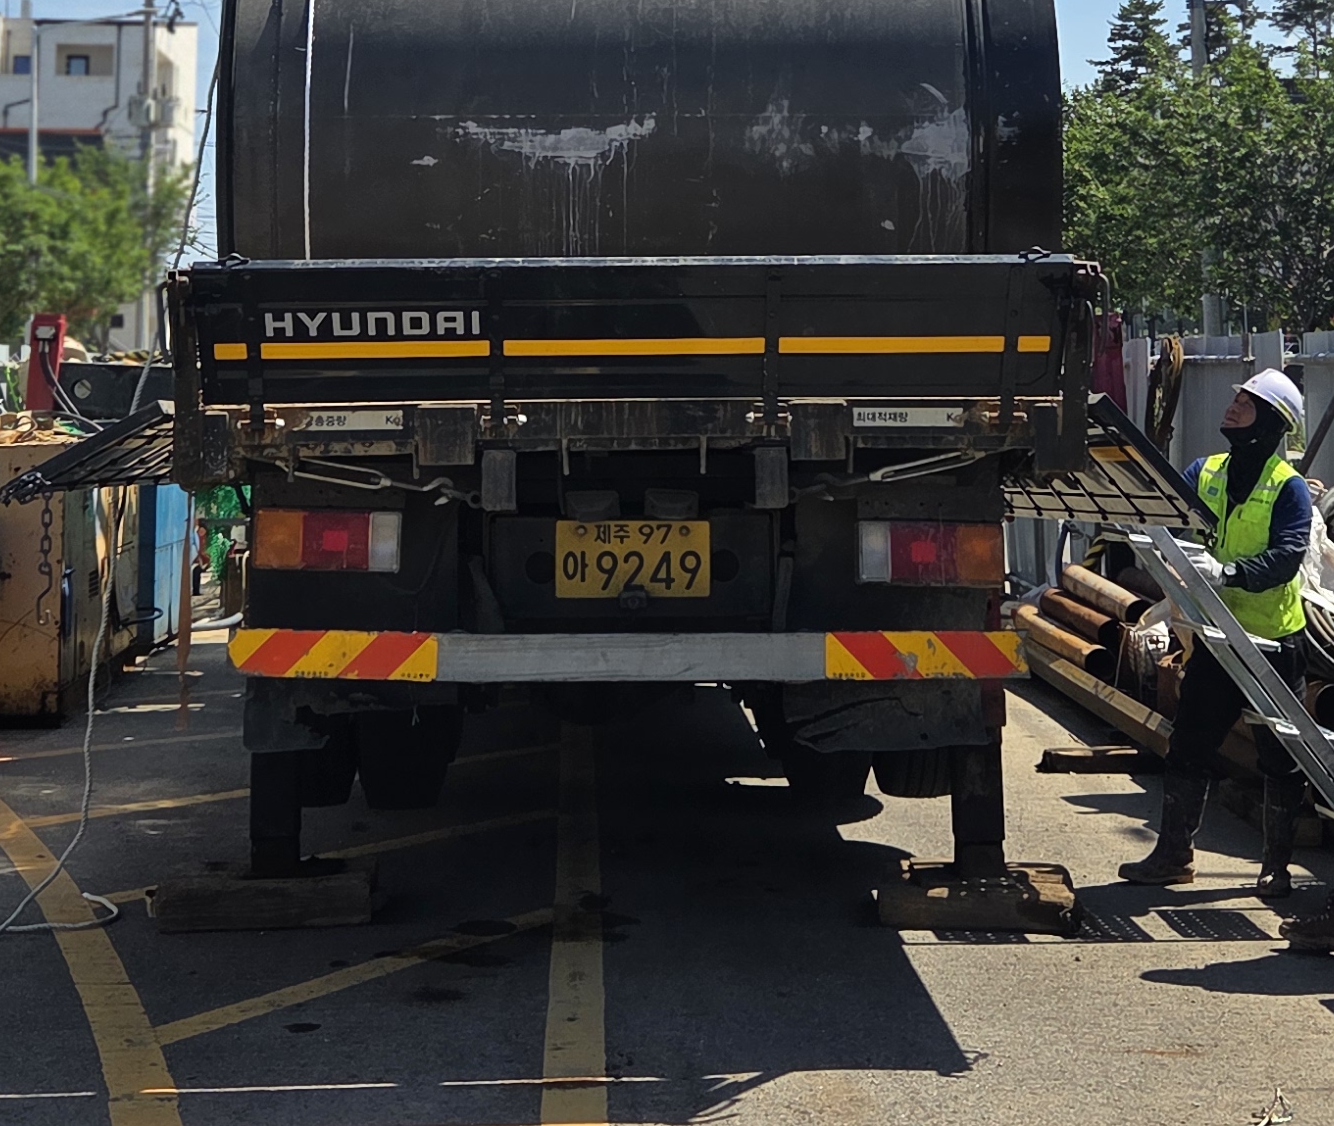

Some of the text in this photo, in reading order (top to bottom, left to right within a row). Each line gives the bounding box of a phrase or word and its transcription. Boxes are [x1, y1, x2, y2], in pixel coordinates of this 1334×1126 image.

[264, 310, 480, 337] HYUNDAI
[856, 411, 908, 423] 최대적재량
[594, 524, 673, 544] 제주 97
